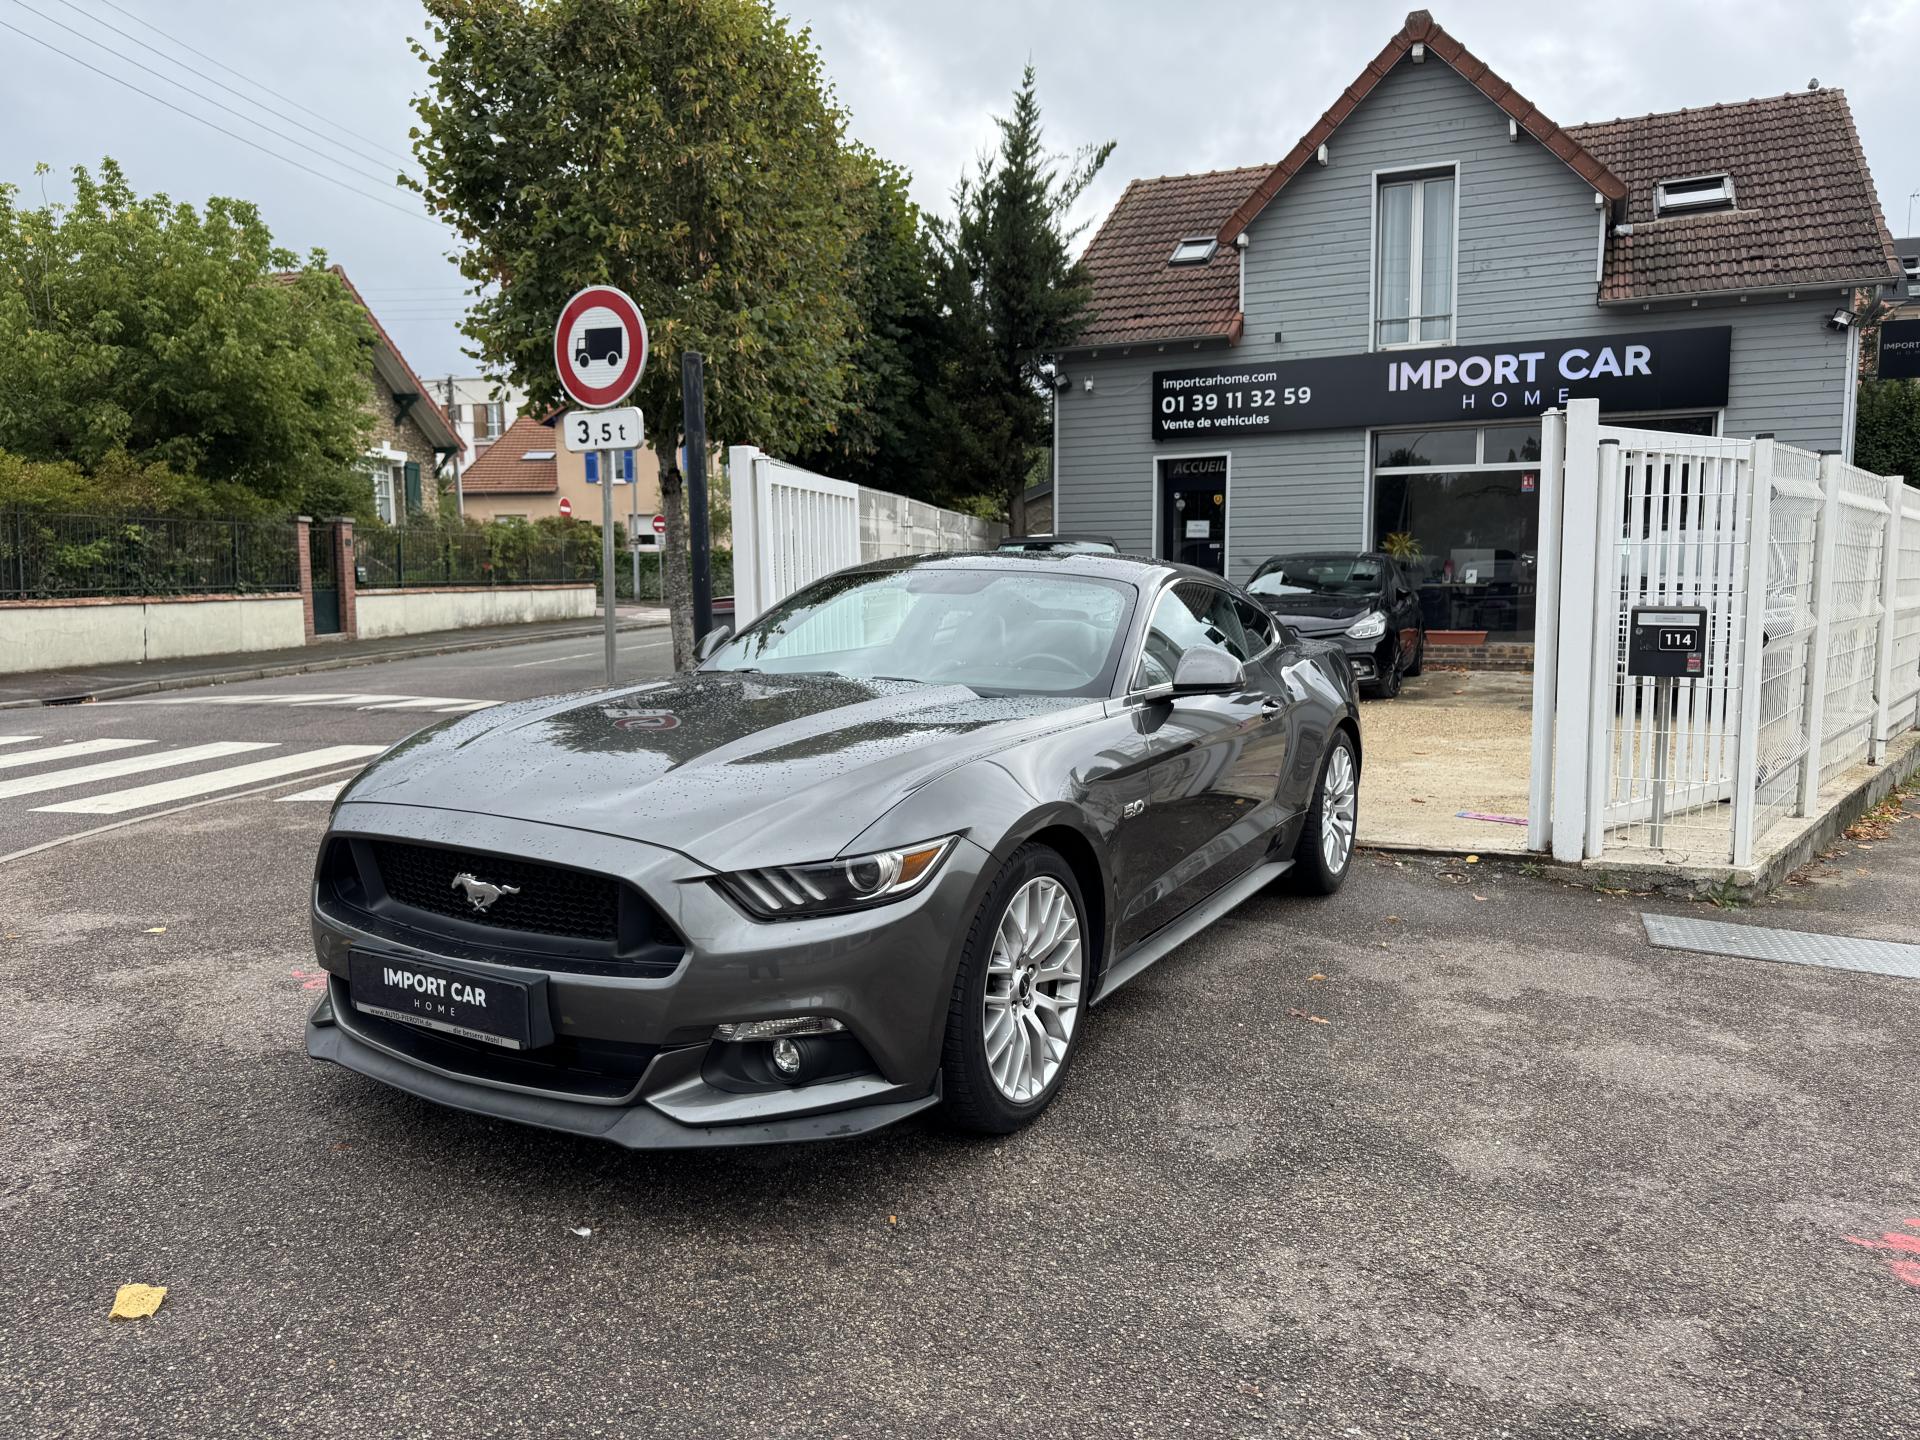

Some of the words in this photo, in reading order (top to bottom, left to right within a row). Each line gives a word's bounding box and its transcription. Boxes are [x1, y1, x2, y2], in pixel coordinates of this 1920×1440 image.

[1388, 352, 1545, 392] IMPORT
[1558, 345, 1651, 381] CAR
[1162, 373, 1277, 390] importcarhome.com
[1161, 396, 1184, 413] 01
[1192, 393, 1218, 411] 39
[1226, 391, 1242, 409] 11
[1250, 389, 1276, 407] 32
[1284, 386, 1311, 405] 59
[1462, 388, 1569, 409] HOME
[1162, 419, 1195, 430] Vente
[1197, 417, 1211, 428] de
[1214, 414, 1270, 427] vehicules
[577, 420, 611, 446] 3,5
[618, 424, 626, 441] t
[1173, 461, 1226, 474] ACCUEIL
[1665, 633, 1692, 646] 114
[1123, 800, 1145, 818] 5.0
[383, 967, 447, 997] IMPORT
[451, 982, 487, 1008] CAR
[414, 999, 455, 1017] HOME
[452, 1027, 463, 1035] die
[463, 1028, 484, 1040] bessere
